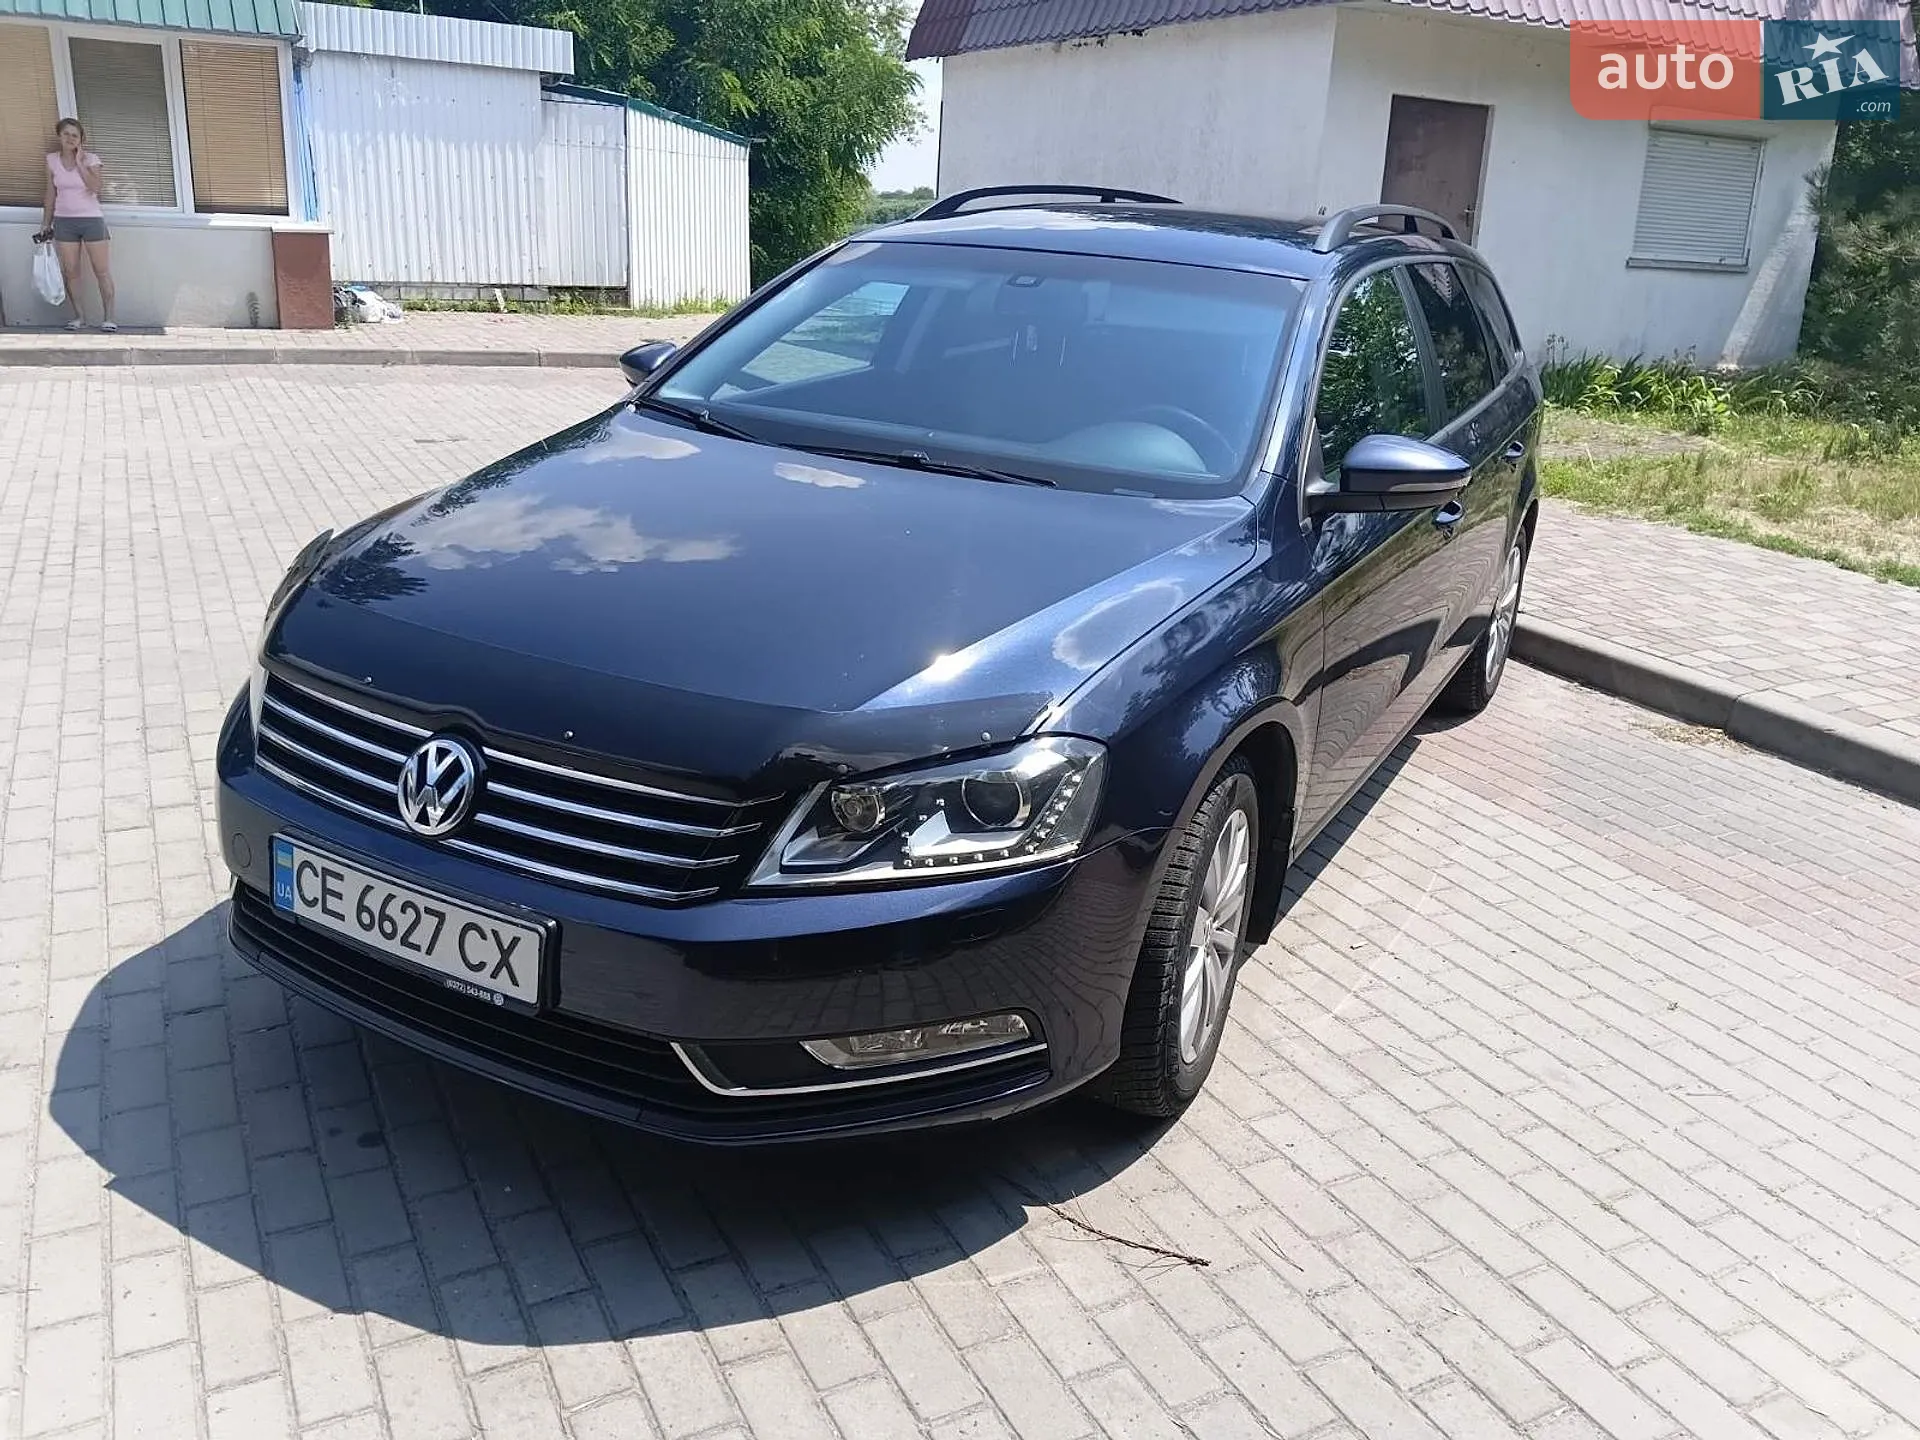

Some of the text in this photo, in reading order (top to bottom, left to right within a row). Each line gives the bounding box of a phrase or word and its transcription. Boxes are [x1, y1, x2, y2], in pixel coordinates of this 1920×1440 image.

[277, 881, 292, 900] UA
[296, 860, 521, 988] CE 6627 CX
